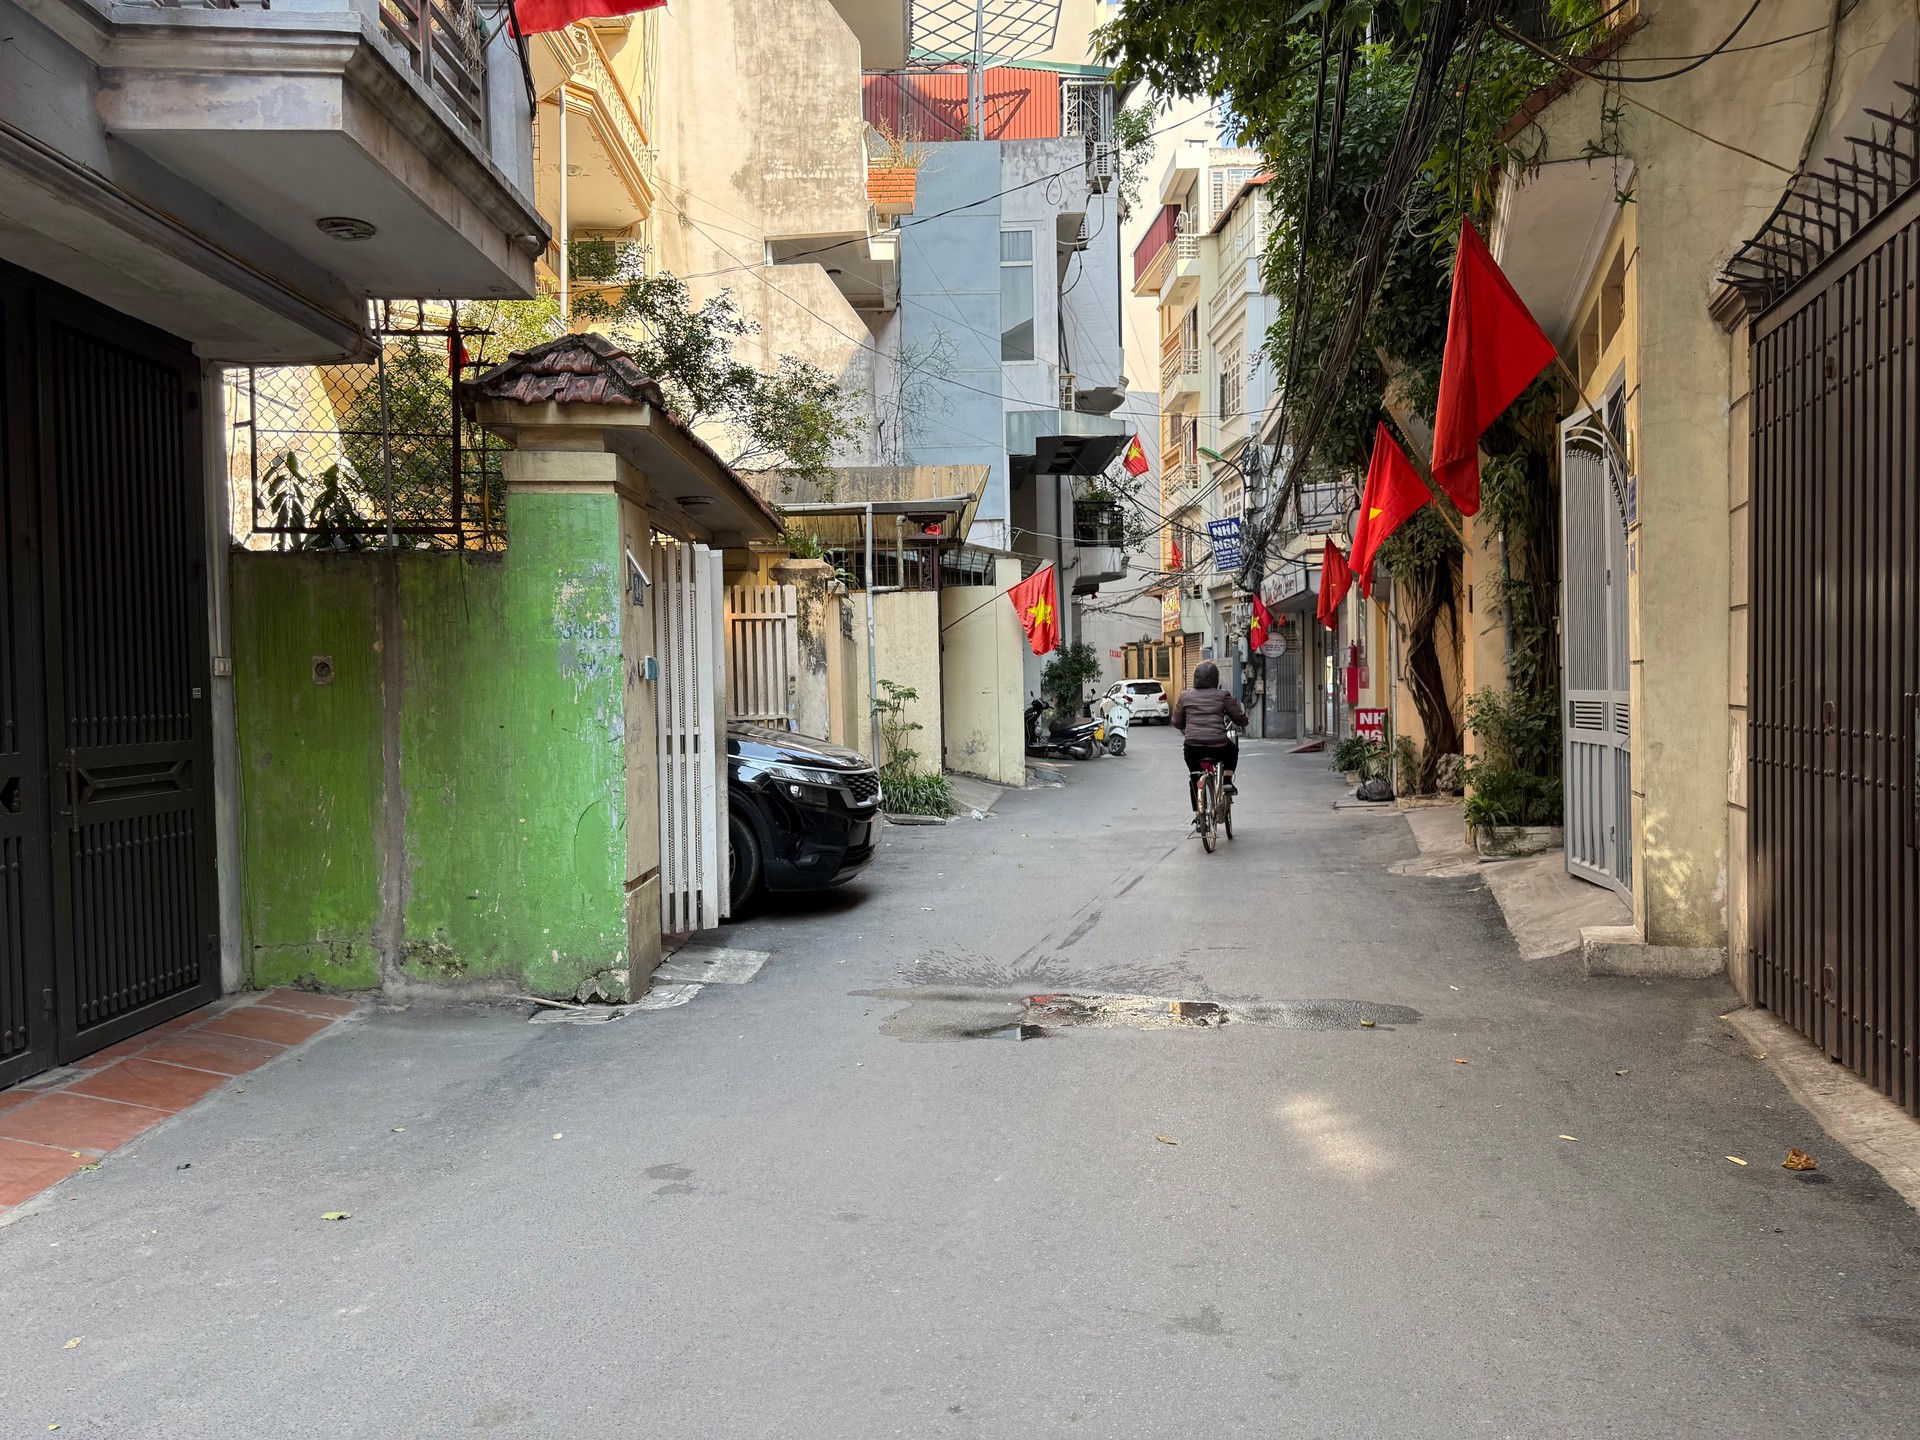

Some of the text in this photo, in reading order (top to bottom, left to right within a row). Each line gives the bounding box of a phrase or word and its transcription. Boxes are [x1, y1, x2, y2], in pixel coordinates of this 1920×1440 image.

[1213, 537, 1240, 551] NGH
[1360, 712, 1385, 724] NH
[1357, 729, 1385, 742] NG
